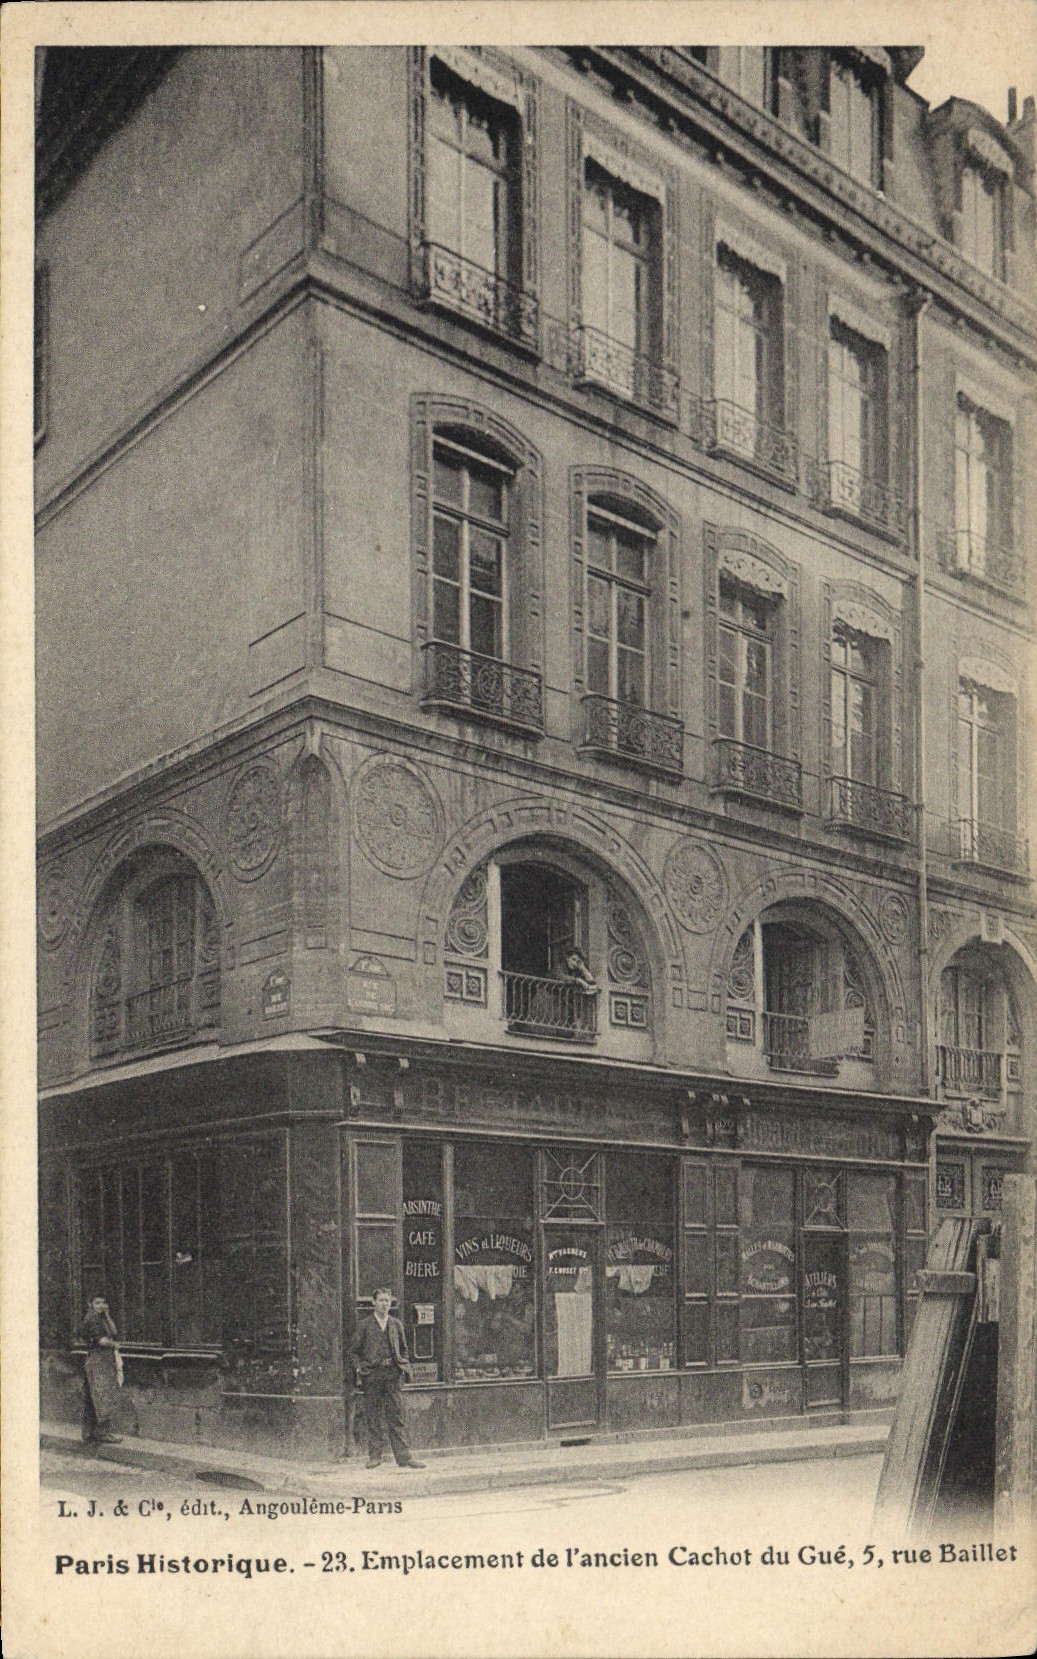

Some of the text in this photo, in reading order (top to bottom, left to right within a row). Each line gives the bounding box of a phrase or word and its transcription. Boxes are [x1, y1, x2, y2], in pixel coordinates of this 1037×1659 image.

[403, 1199, 443, 1217] ABSINTHE
[455, 1236, 480, 1260] VINS
[490, 1233, 533, 1262] LIQUEURS
